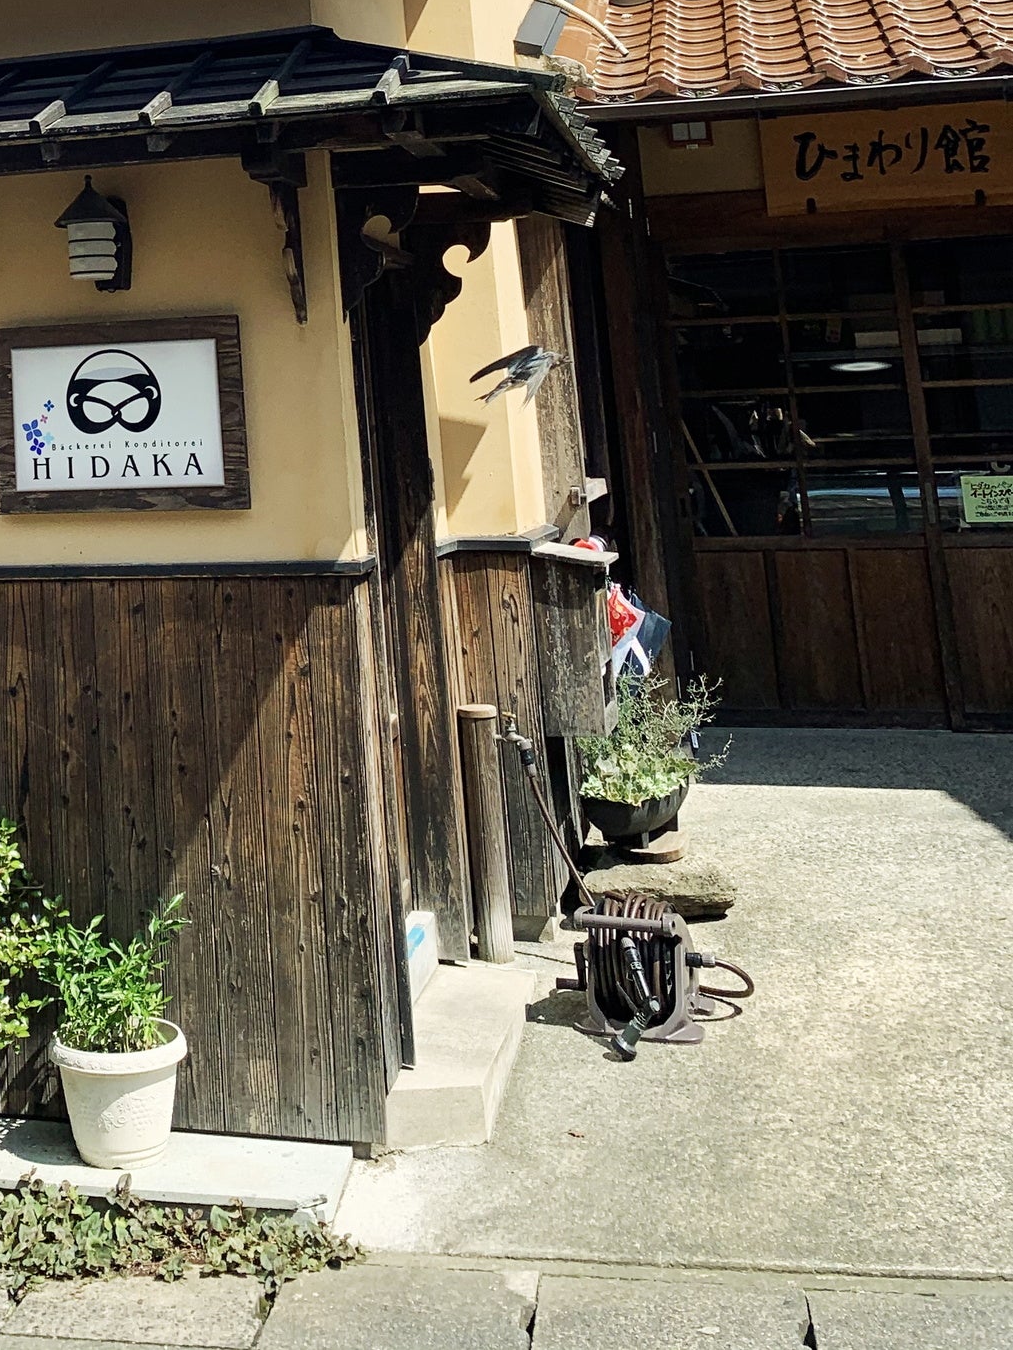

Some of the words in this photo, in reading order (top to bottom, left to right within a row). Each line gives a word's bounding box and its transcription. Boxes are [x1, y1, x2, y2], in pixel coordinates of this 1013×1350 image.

[793, 118, 991, 182] ひまわり館
[125, 439, 203, 449] Konditorei
[32, 453, 204, 480] HIDAKA
